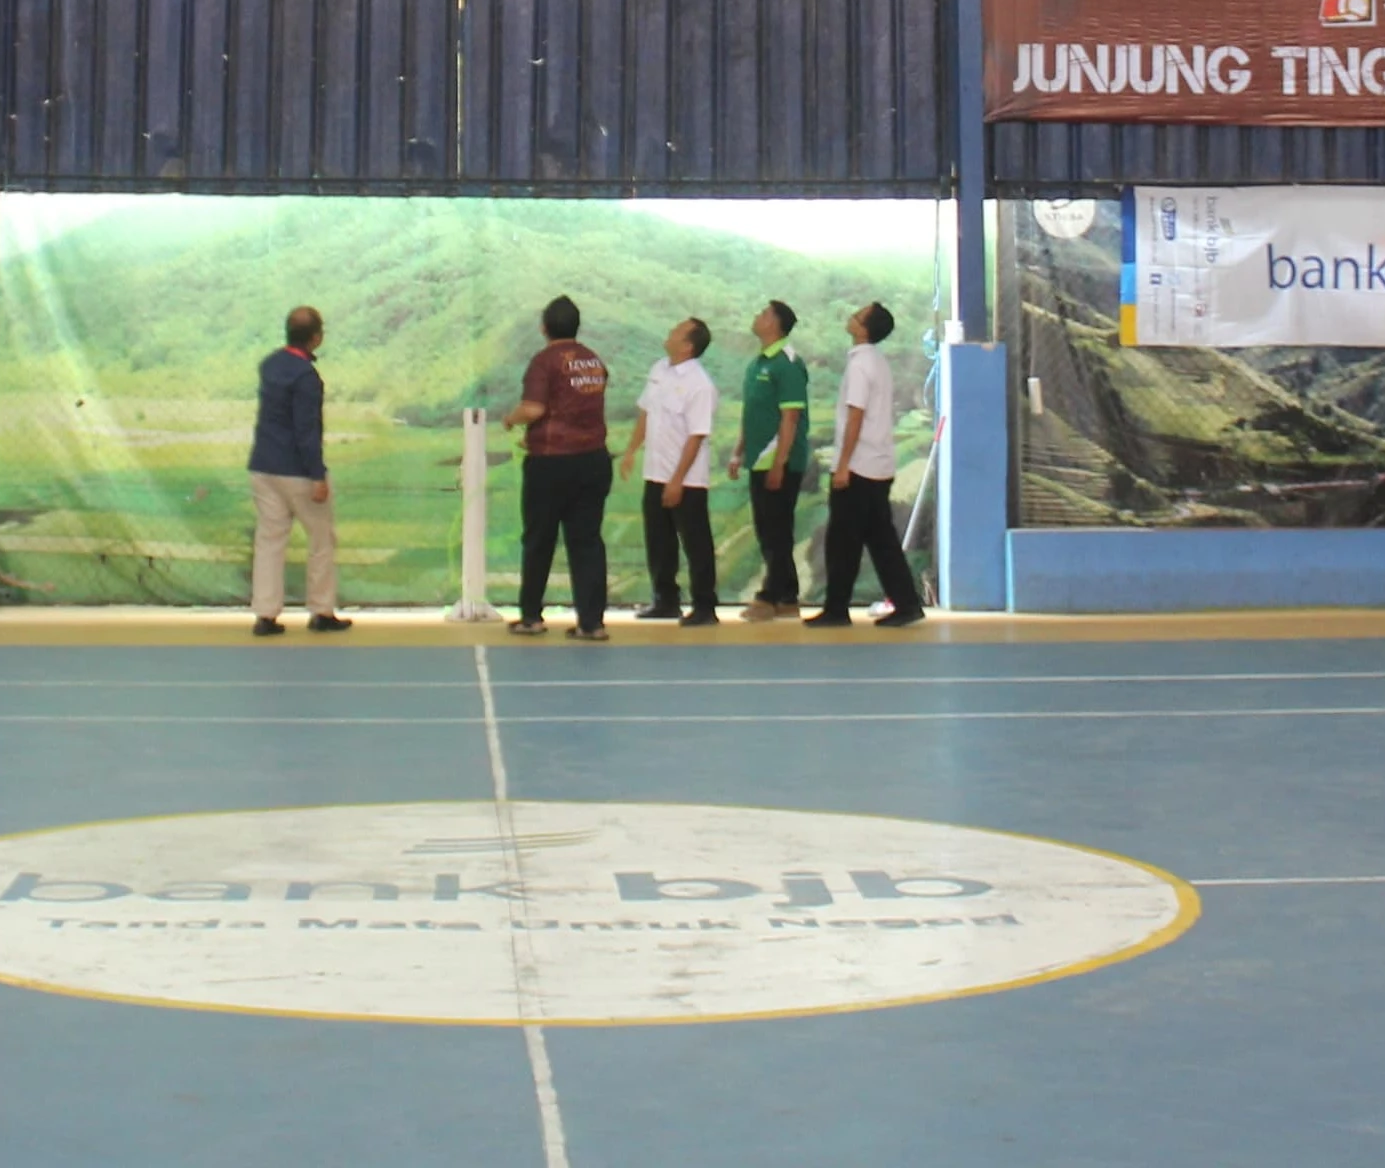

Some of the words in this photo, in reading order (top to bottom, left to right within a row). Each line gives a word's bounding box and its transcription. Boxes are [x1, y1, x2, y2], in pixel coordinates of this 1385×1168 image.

[1013, 43, 1252, 95] JUNJUNG
[613, 870, 993, 907] bjb
[38, 918, 266, 928] Tanda
[298, 918, 482, 929] Mata
[510, 919, 741, 929] Untuk
[768, 914, 1024, 928] Negeri
